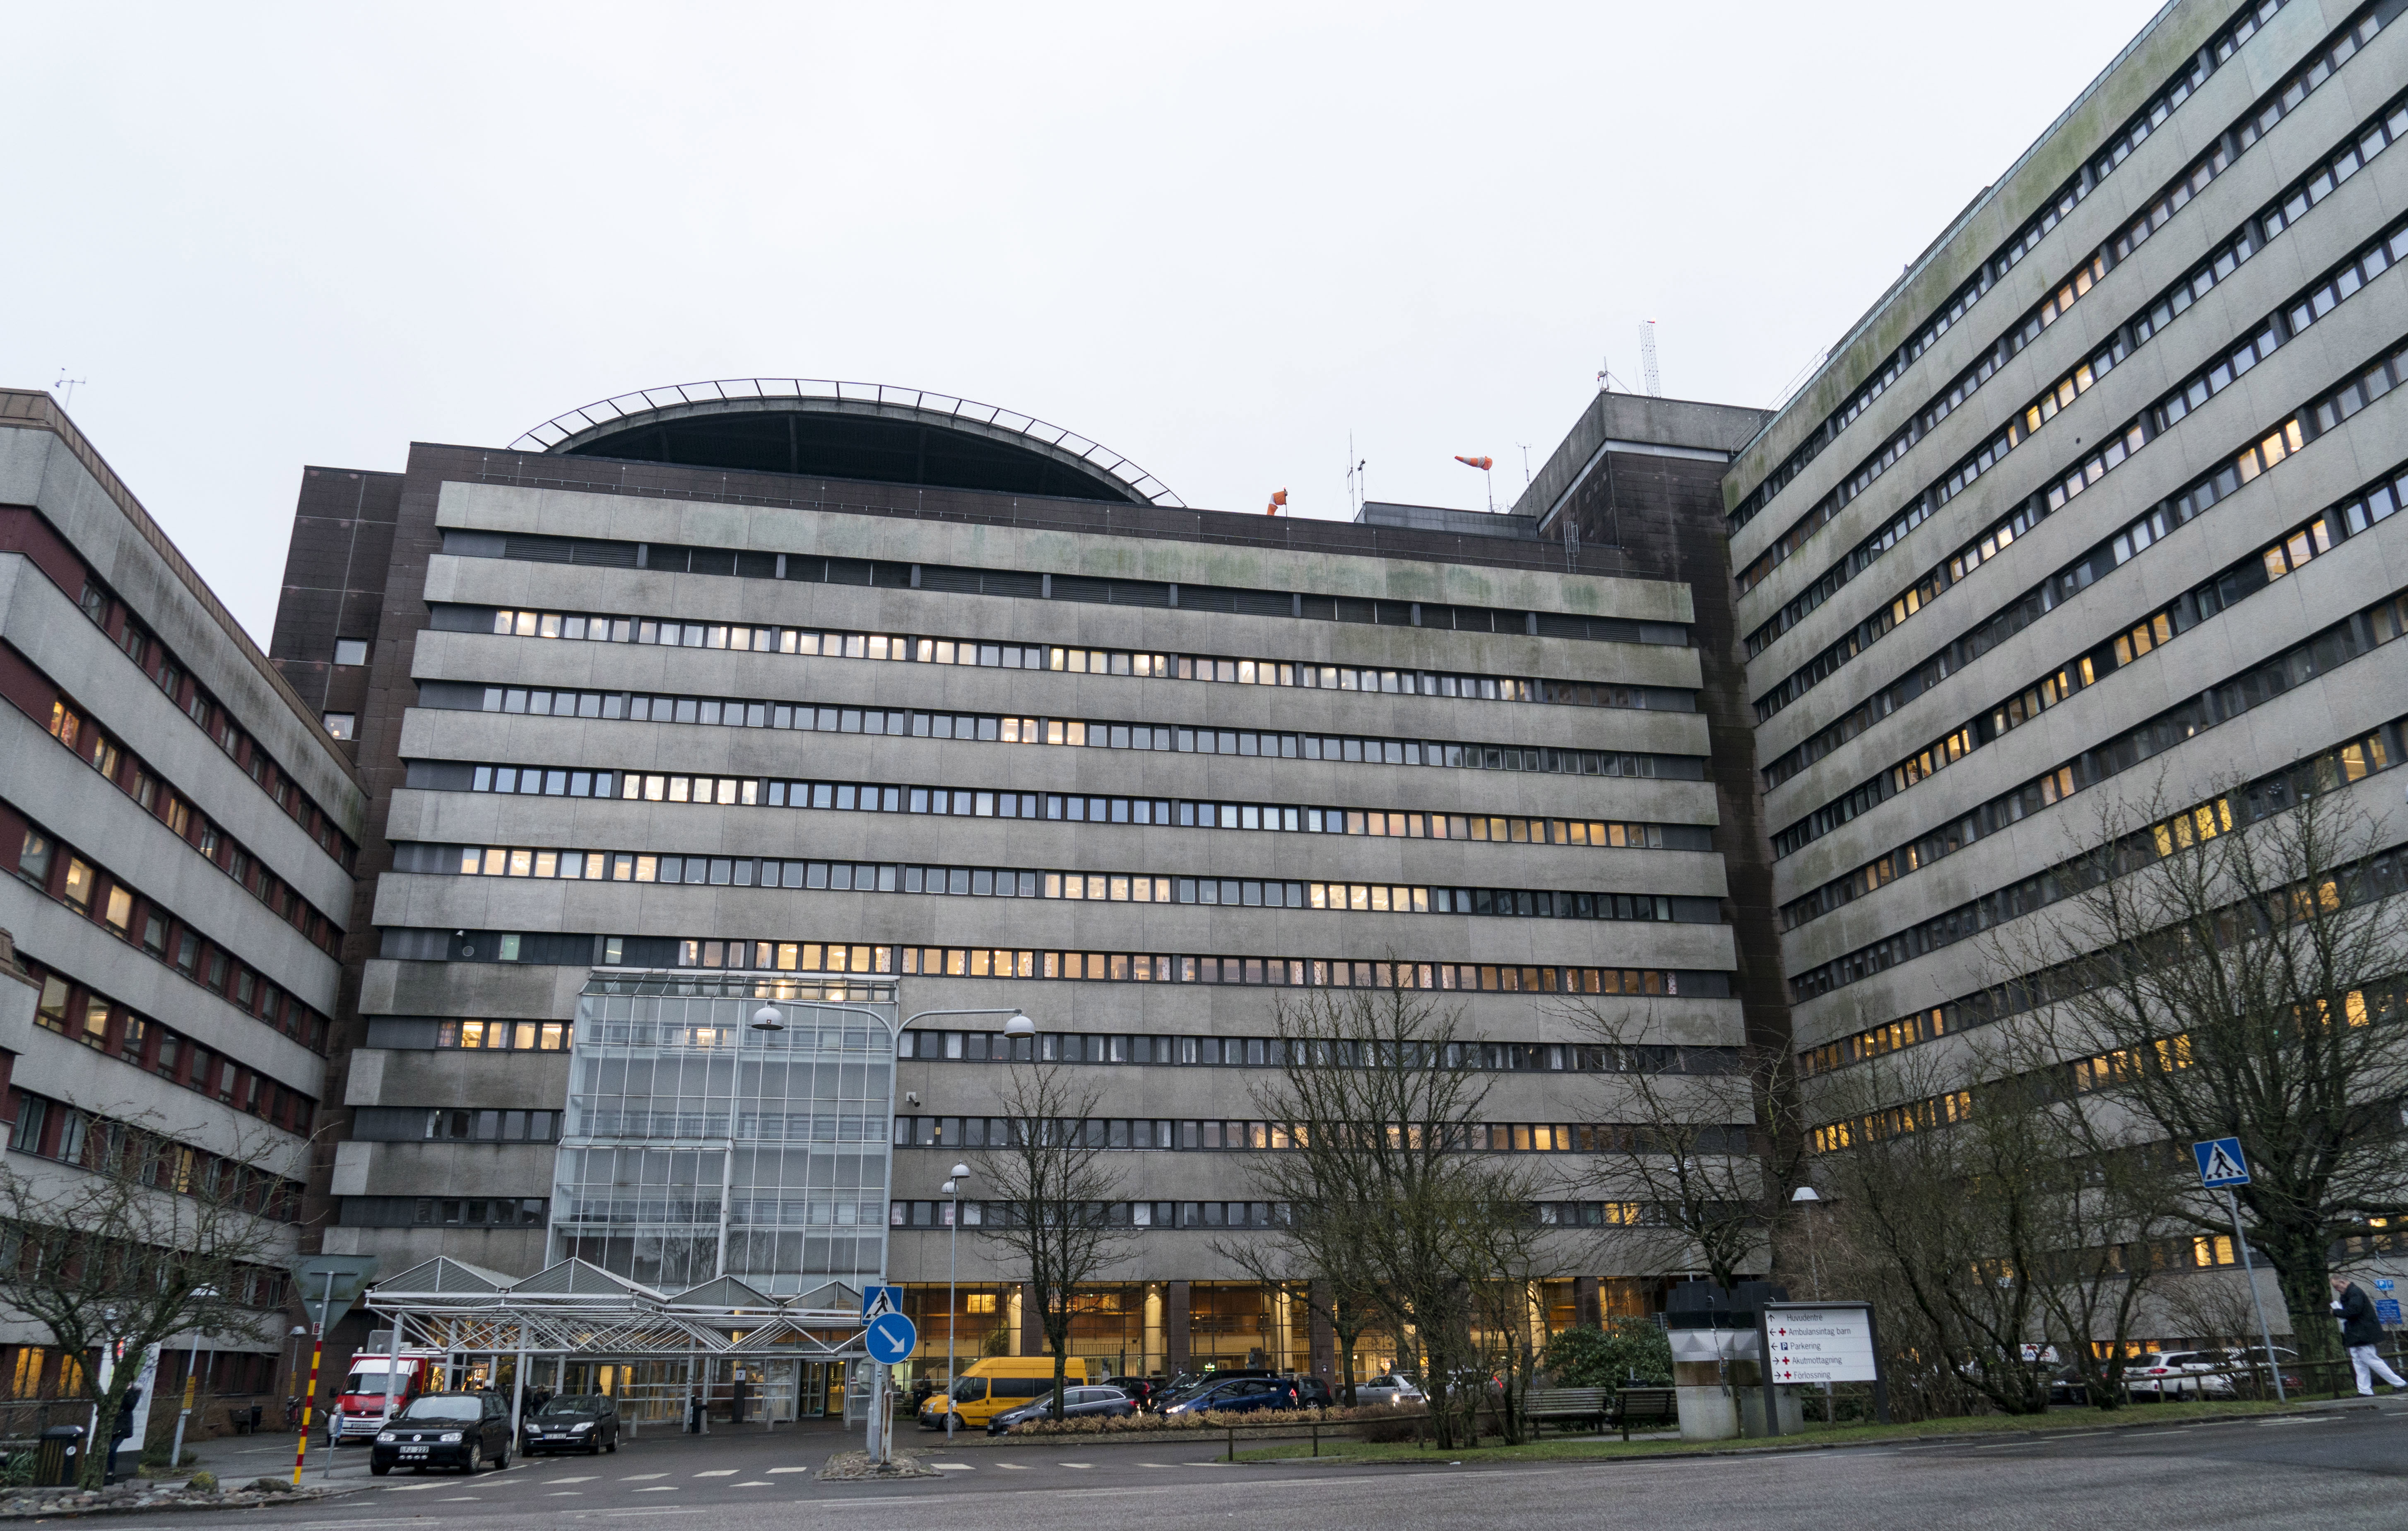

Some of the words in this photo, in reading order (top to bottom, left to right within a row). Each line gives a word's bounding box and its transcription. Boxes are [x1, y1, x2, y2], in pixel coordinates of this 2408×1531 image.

[1789, 1328, 1835, 1336] Ambulansintag
[1790, 1342, 1821, 1351] Parkering
[1792, 1356, 1842, 1365] Akutmottagning
[1794, 1371, 1831, 1379] Förlossning
